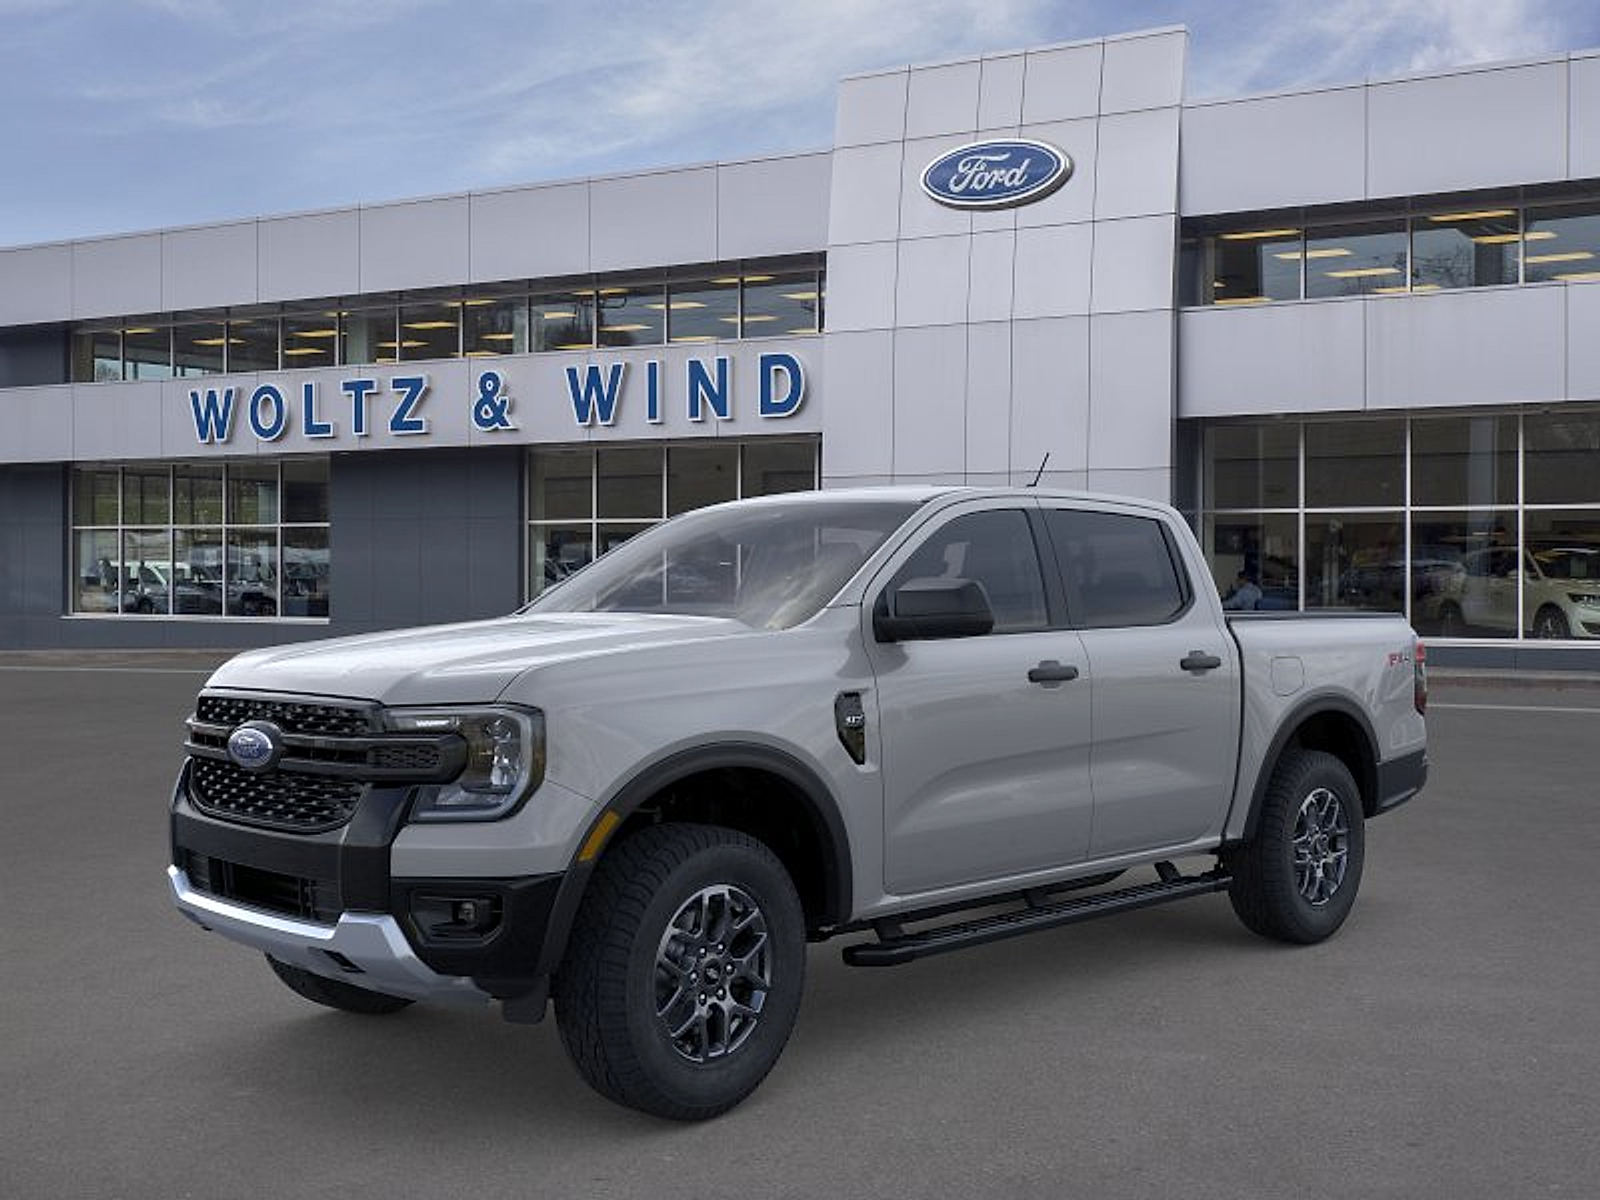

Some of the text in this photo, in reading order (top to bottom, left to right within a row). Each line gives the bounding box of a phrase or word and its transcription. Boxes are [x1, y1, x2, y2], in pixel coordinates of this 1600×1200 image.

[949, 152, 1031, 193] Ford
[189, 352, 807, 444] WOLTZ & WIND
